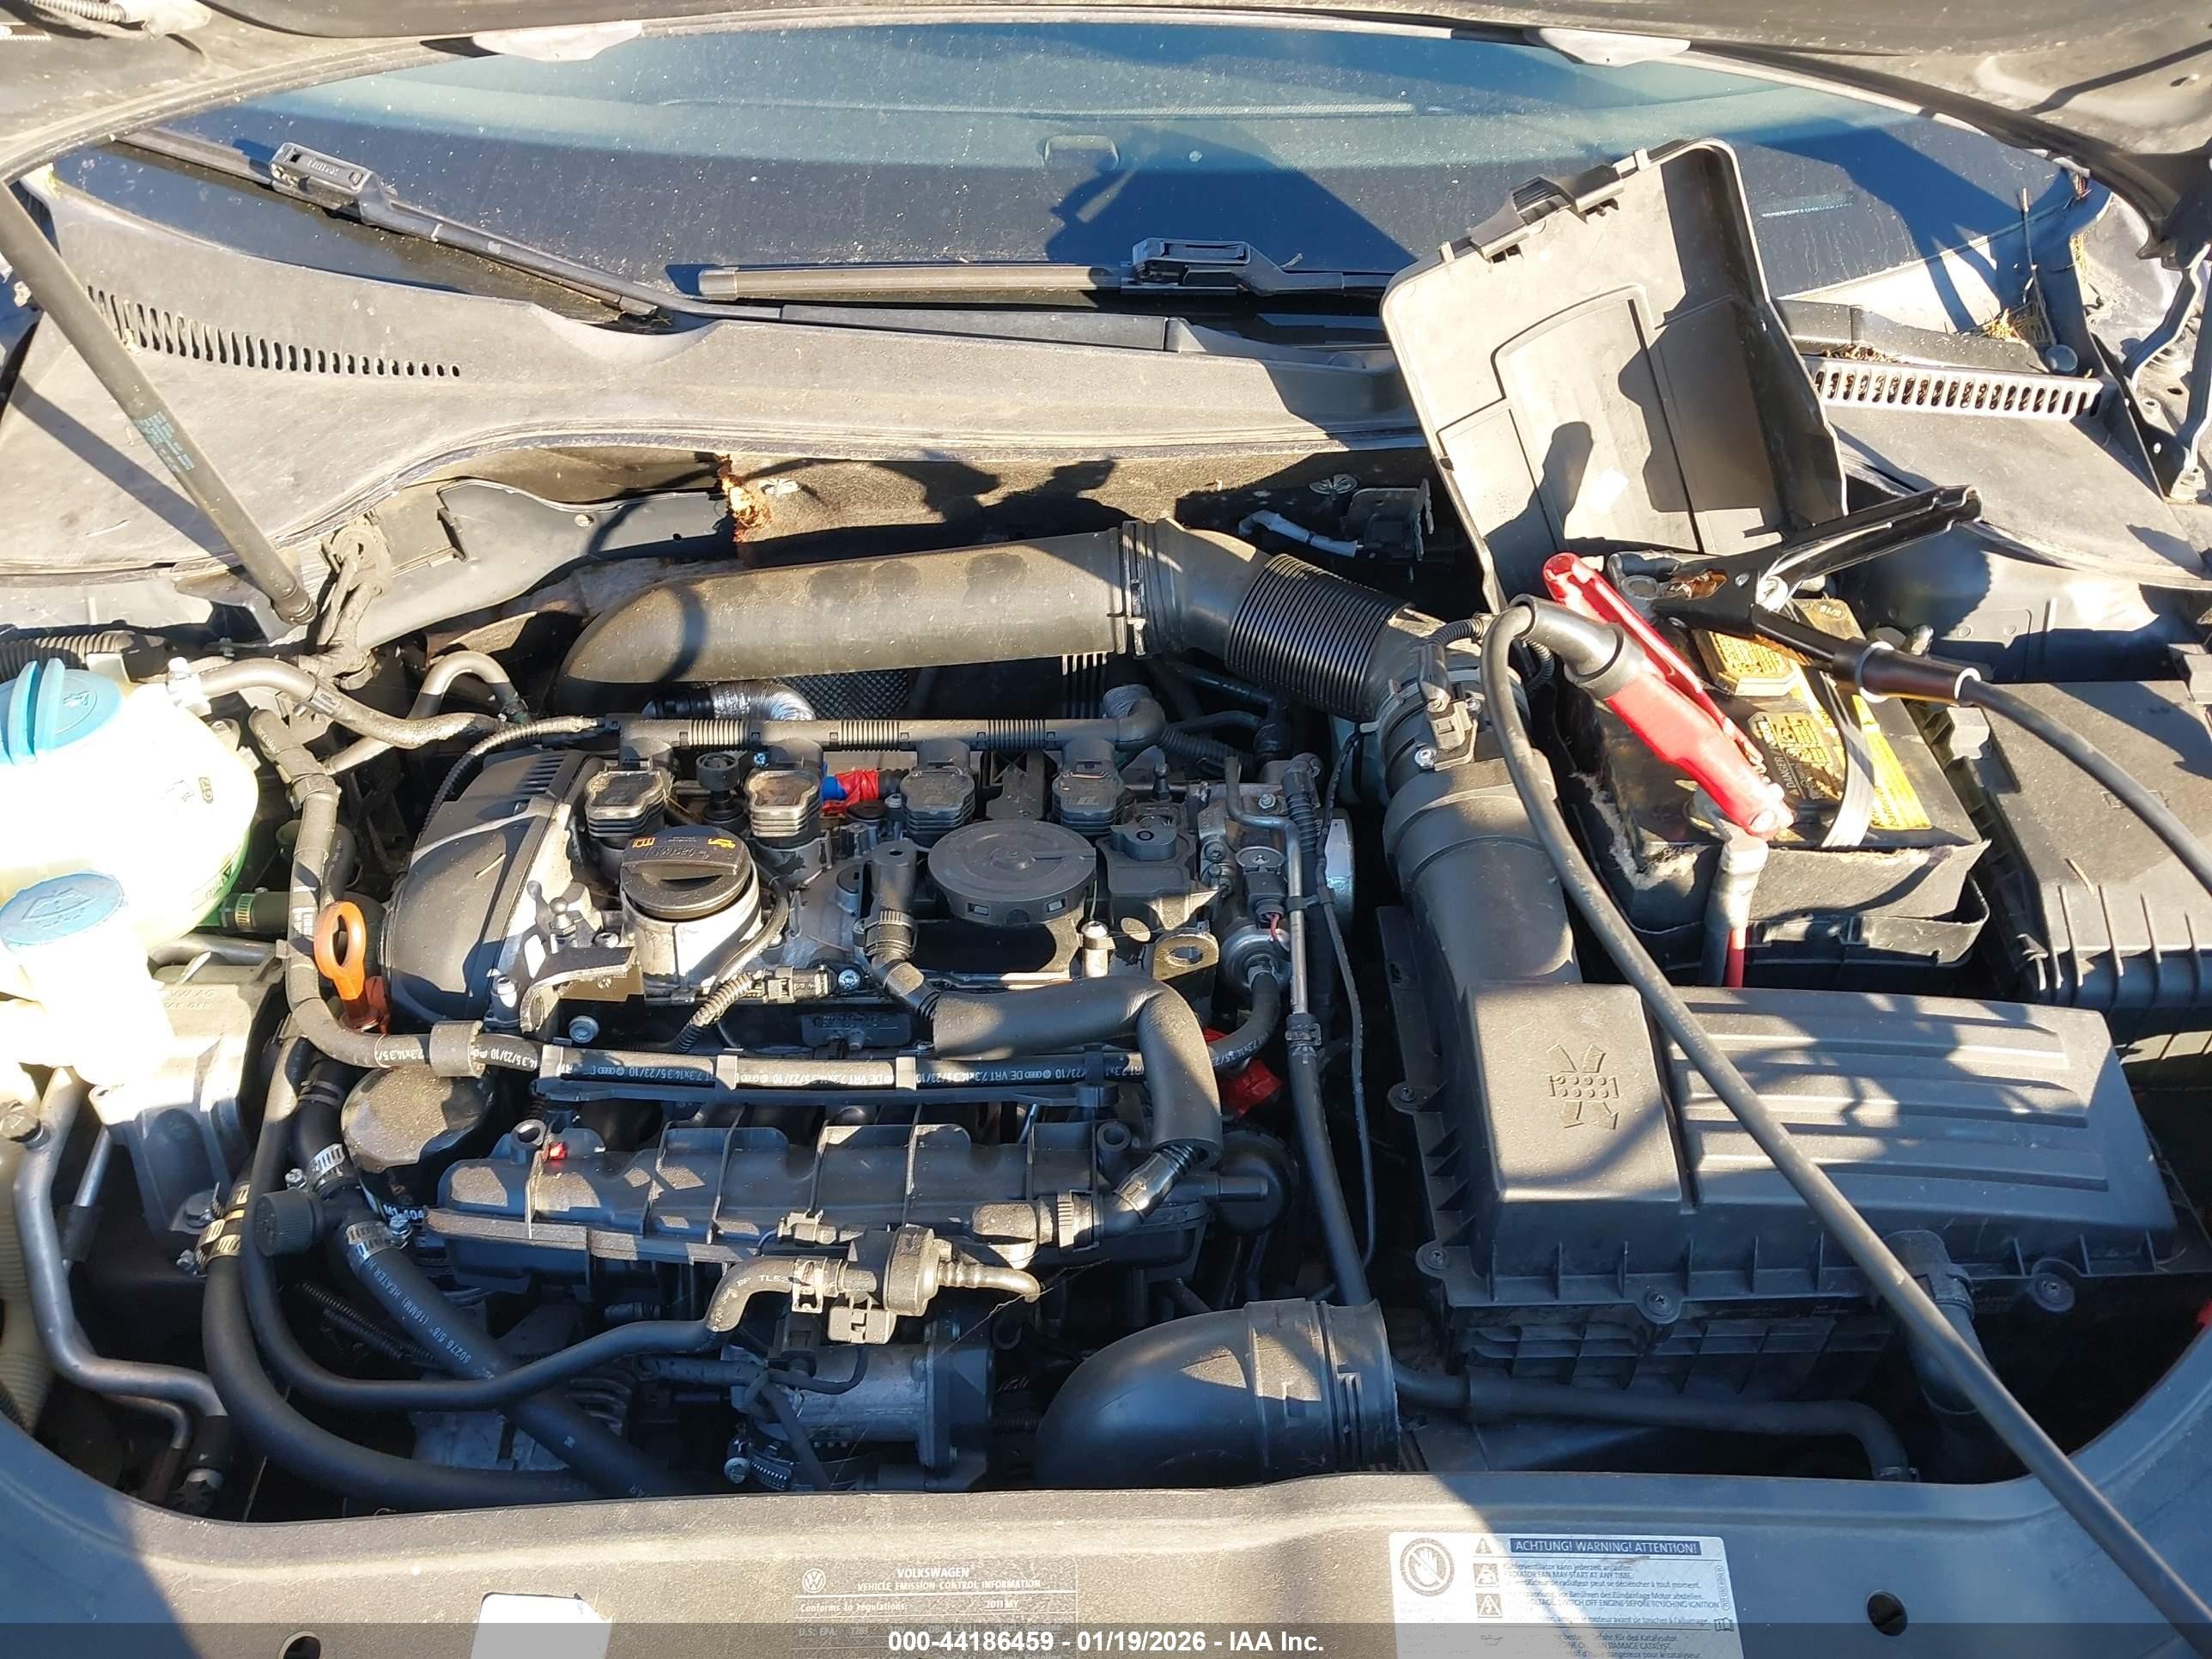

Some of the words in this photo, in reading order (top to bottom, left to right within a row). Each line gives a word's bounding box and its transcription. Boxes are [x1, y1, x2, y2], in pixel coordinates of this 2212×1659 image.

[1774, 756, 1797, 789] DANGER
[989, 1070, 1008, 1082] VRT
[1011, 1070, 1024, 1080] DE
[374, 1267, 403, 1299] HEATER
[758, 1274, 789, 1285] TL52
[1516, 1540, 1572, 1553] ACHTUNG!
[1577, 1540, 1632, 1553] WARNING!
[1635, 1542, 1697, 1554] ATTENTION!
[896, 1567, 969, 1578] VOLKSWAGEN
[857, 1581, 891, 1591] VEHICLE
[895, 1581, 935, 1591] EMISSION
[939, 1580, 977, 1589] CONTROL
[981, 1579, 1042, 1589] INFORMATION
[800, 1601, 840, 1613] Conforms
[844, 1601, 854, 1612] to
[985, 1600, 1004, 1609] 2011
[1608, 1641, 1638, 1650] DAMAGE
